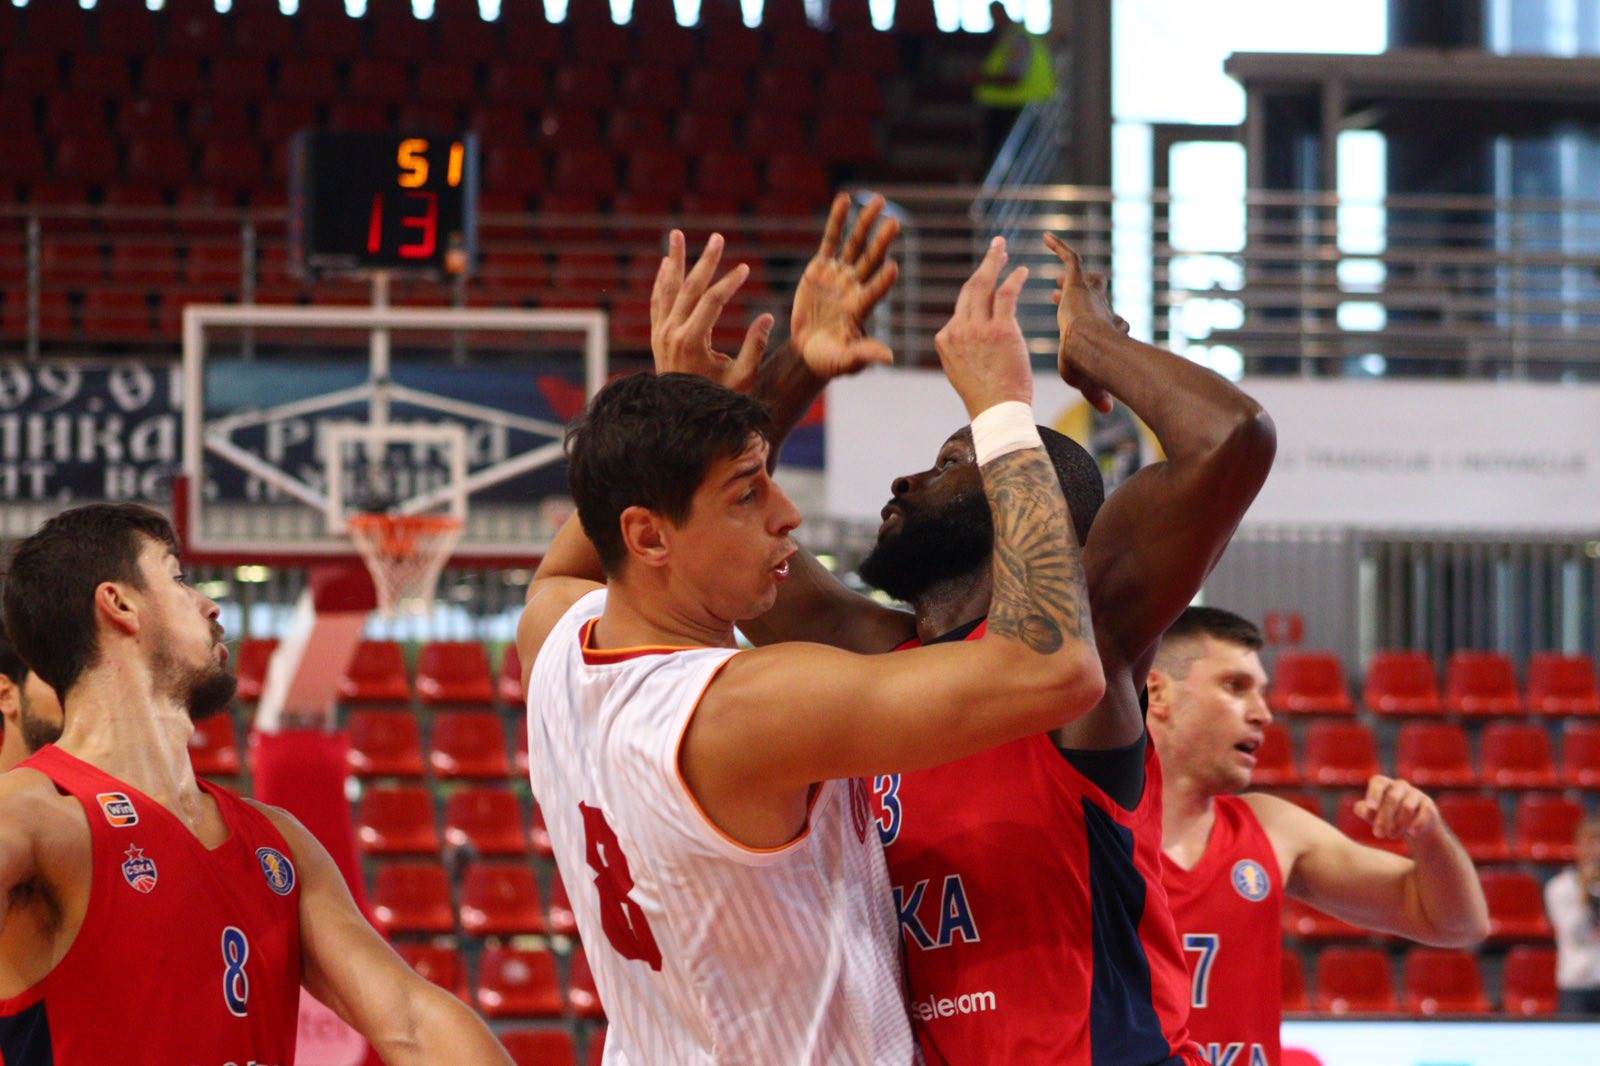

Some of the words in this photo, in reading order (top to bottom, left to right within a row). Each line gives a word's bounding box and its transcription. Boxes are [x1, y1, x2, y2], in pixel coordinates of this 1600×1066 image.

[397, 138, 464, 188] 51
[367, 191, 439, 259] 13
[578, 800, 662, 972] 8
[221, 925, 250, 1018] 8
[1182, 933, 1220, 1009] 7
